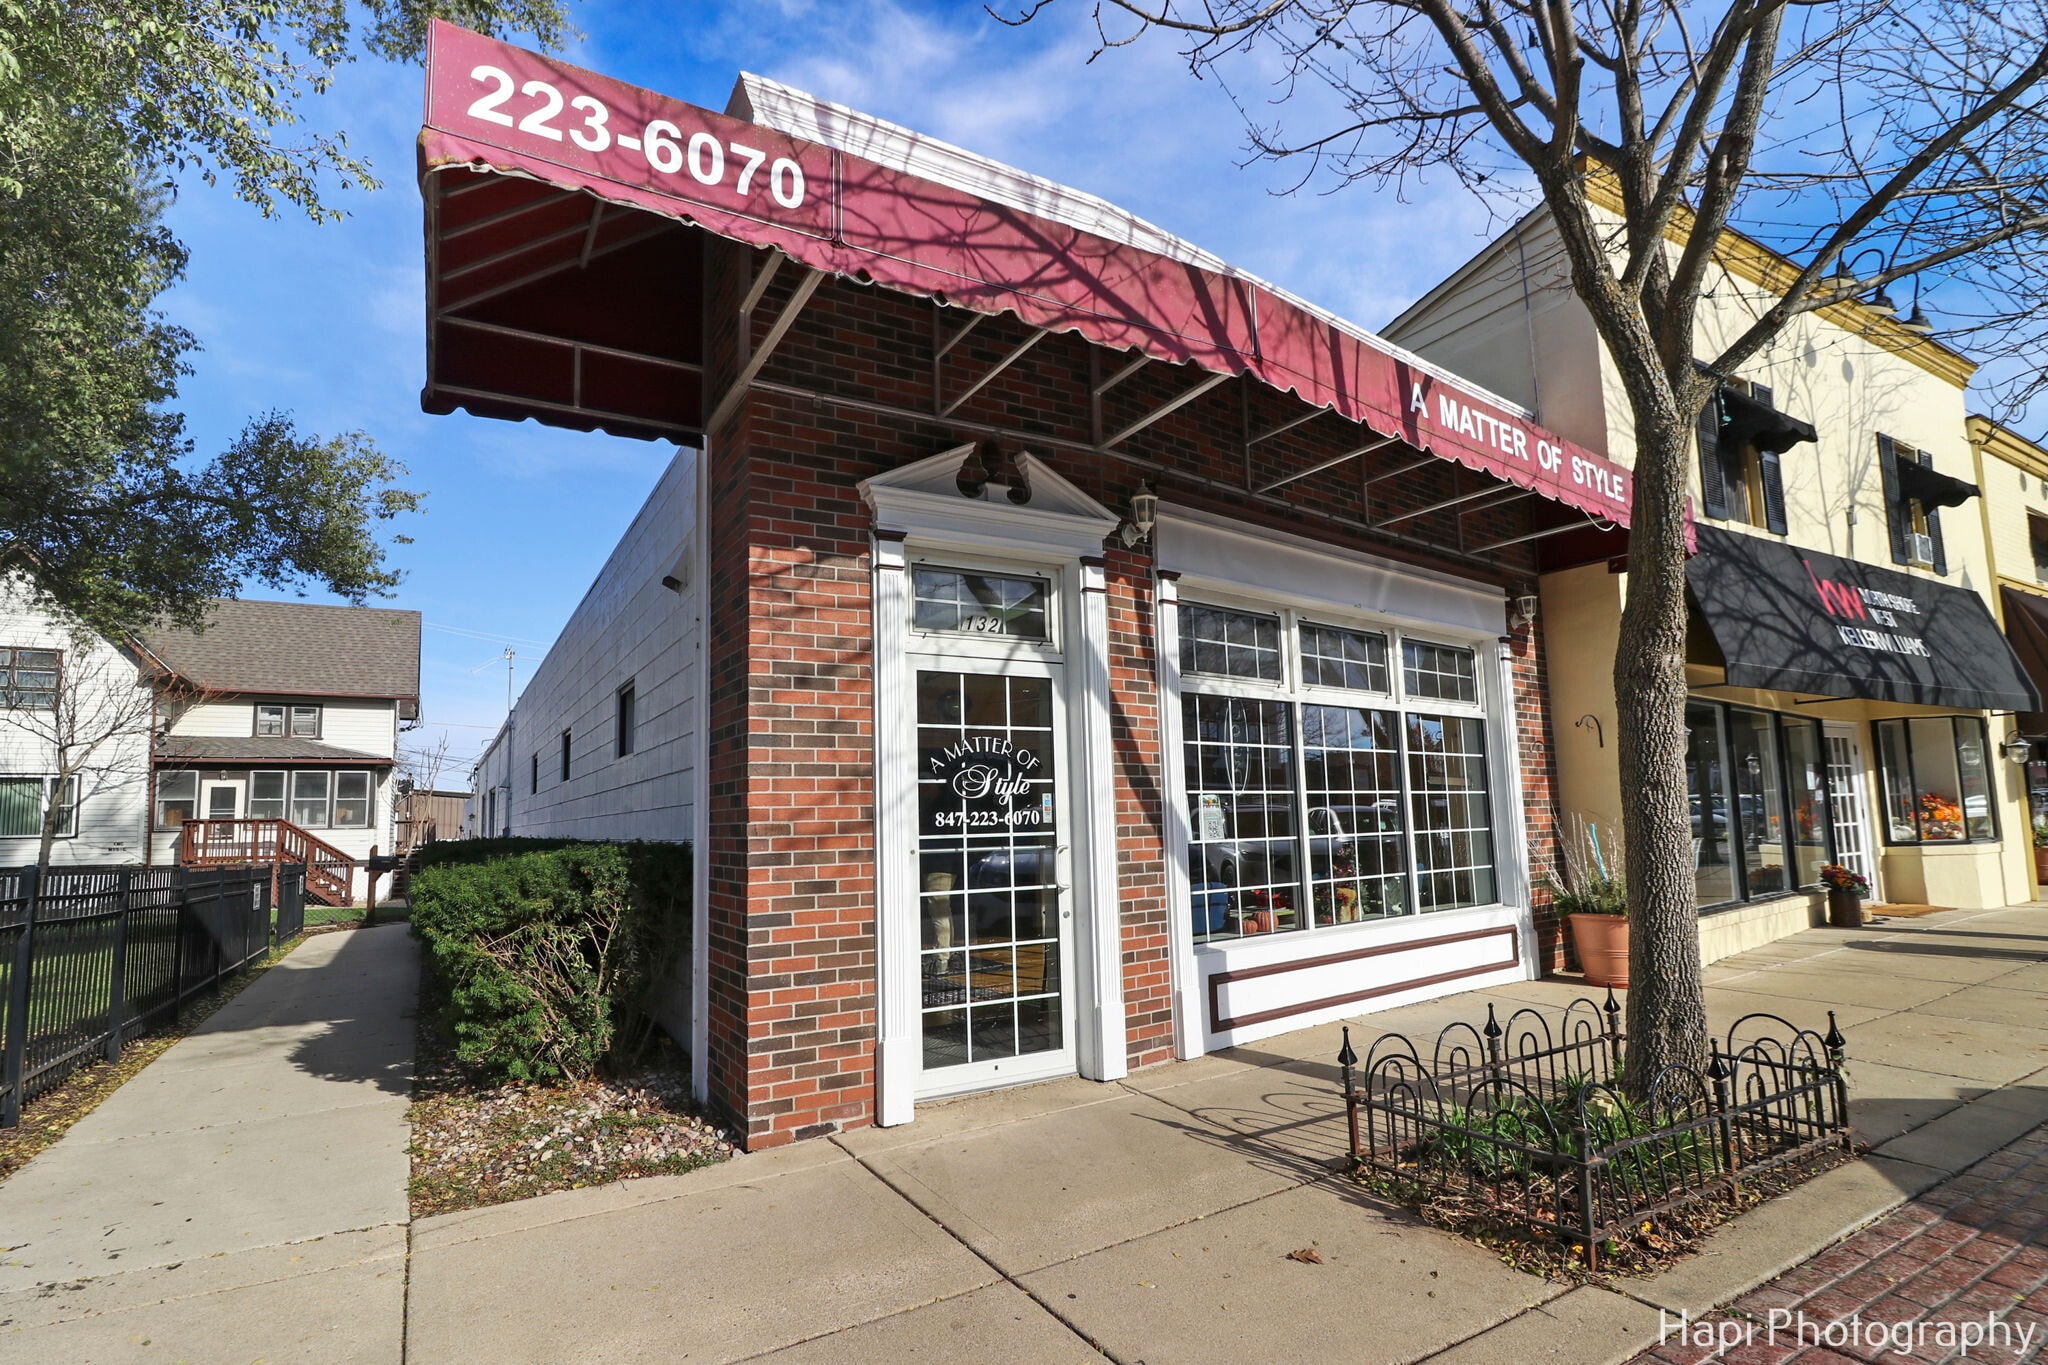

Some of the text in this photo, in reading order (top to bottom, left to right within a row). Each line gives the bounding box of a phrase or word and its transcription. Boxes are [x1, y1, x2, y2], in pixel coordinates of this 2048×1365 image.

[466, 65, 805, 209] 223-6070
[1410, 382, 1625, 502] A MATTER OF STYLE
[966, 615, 998, 633] 132
[1867, 607, 1898, 628] WEST
[930, 736, 1040, 774] A MATTER OF
[953, 764, 1030, 805] Style
[935, 810, 1040, 827] 847-223-6070
